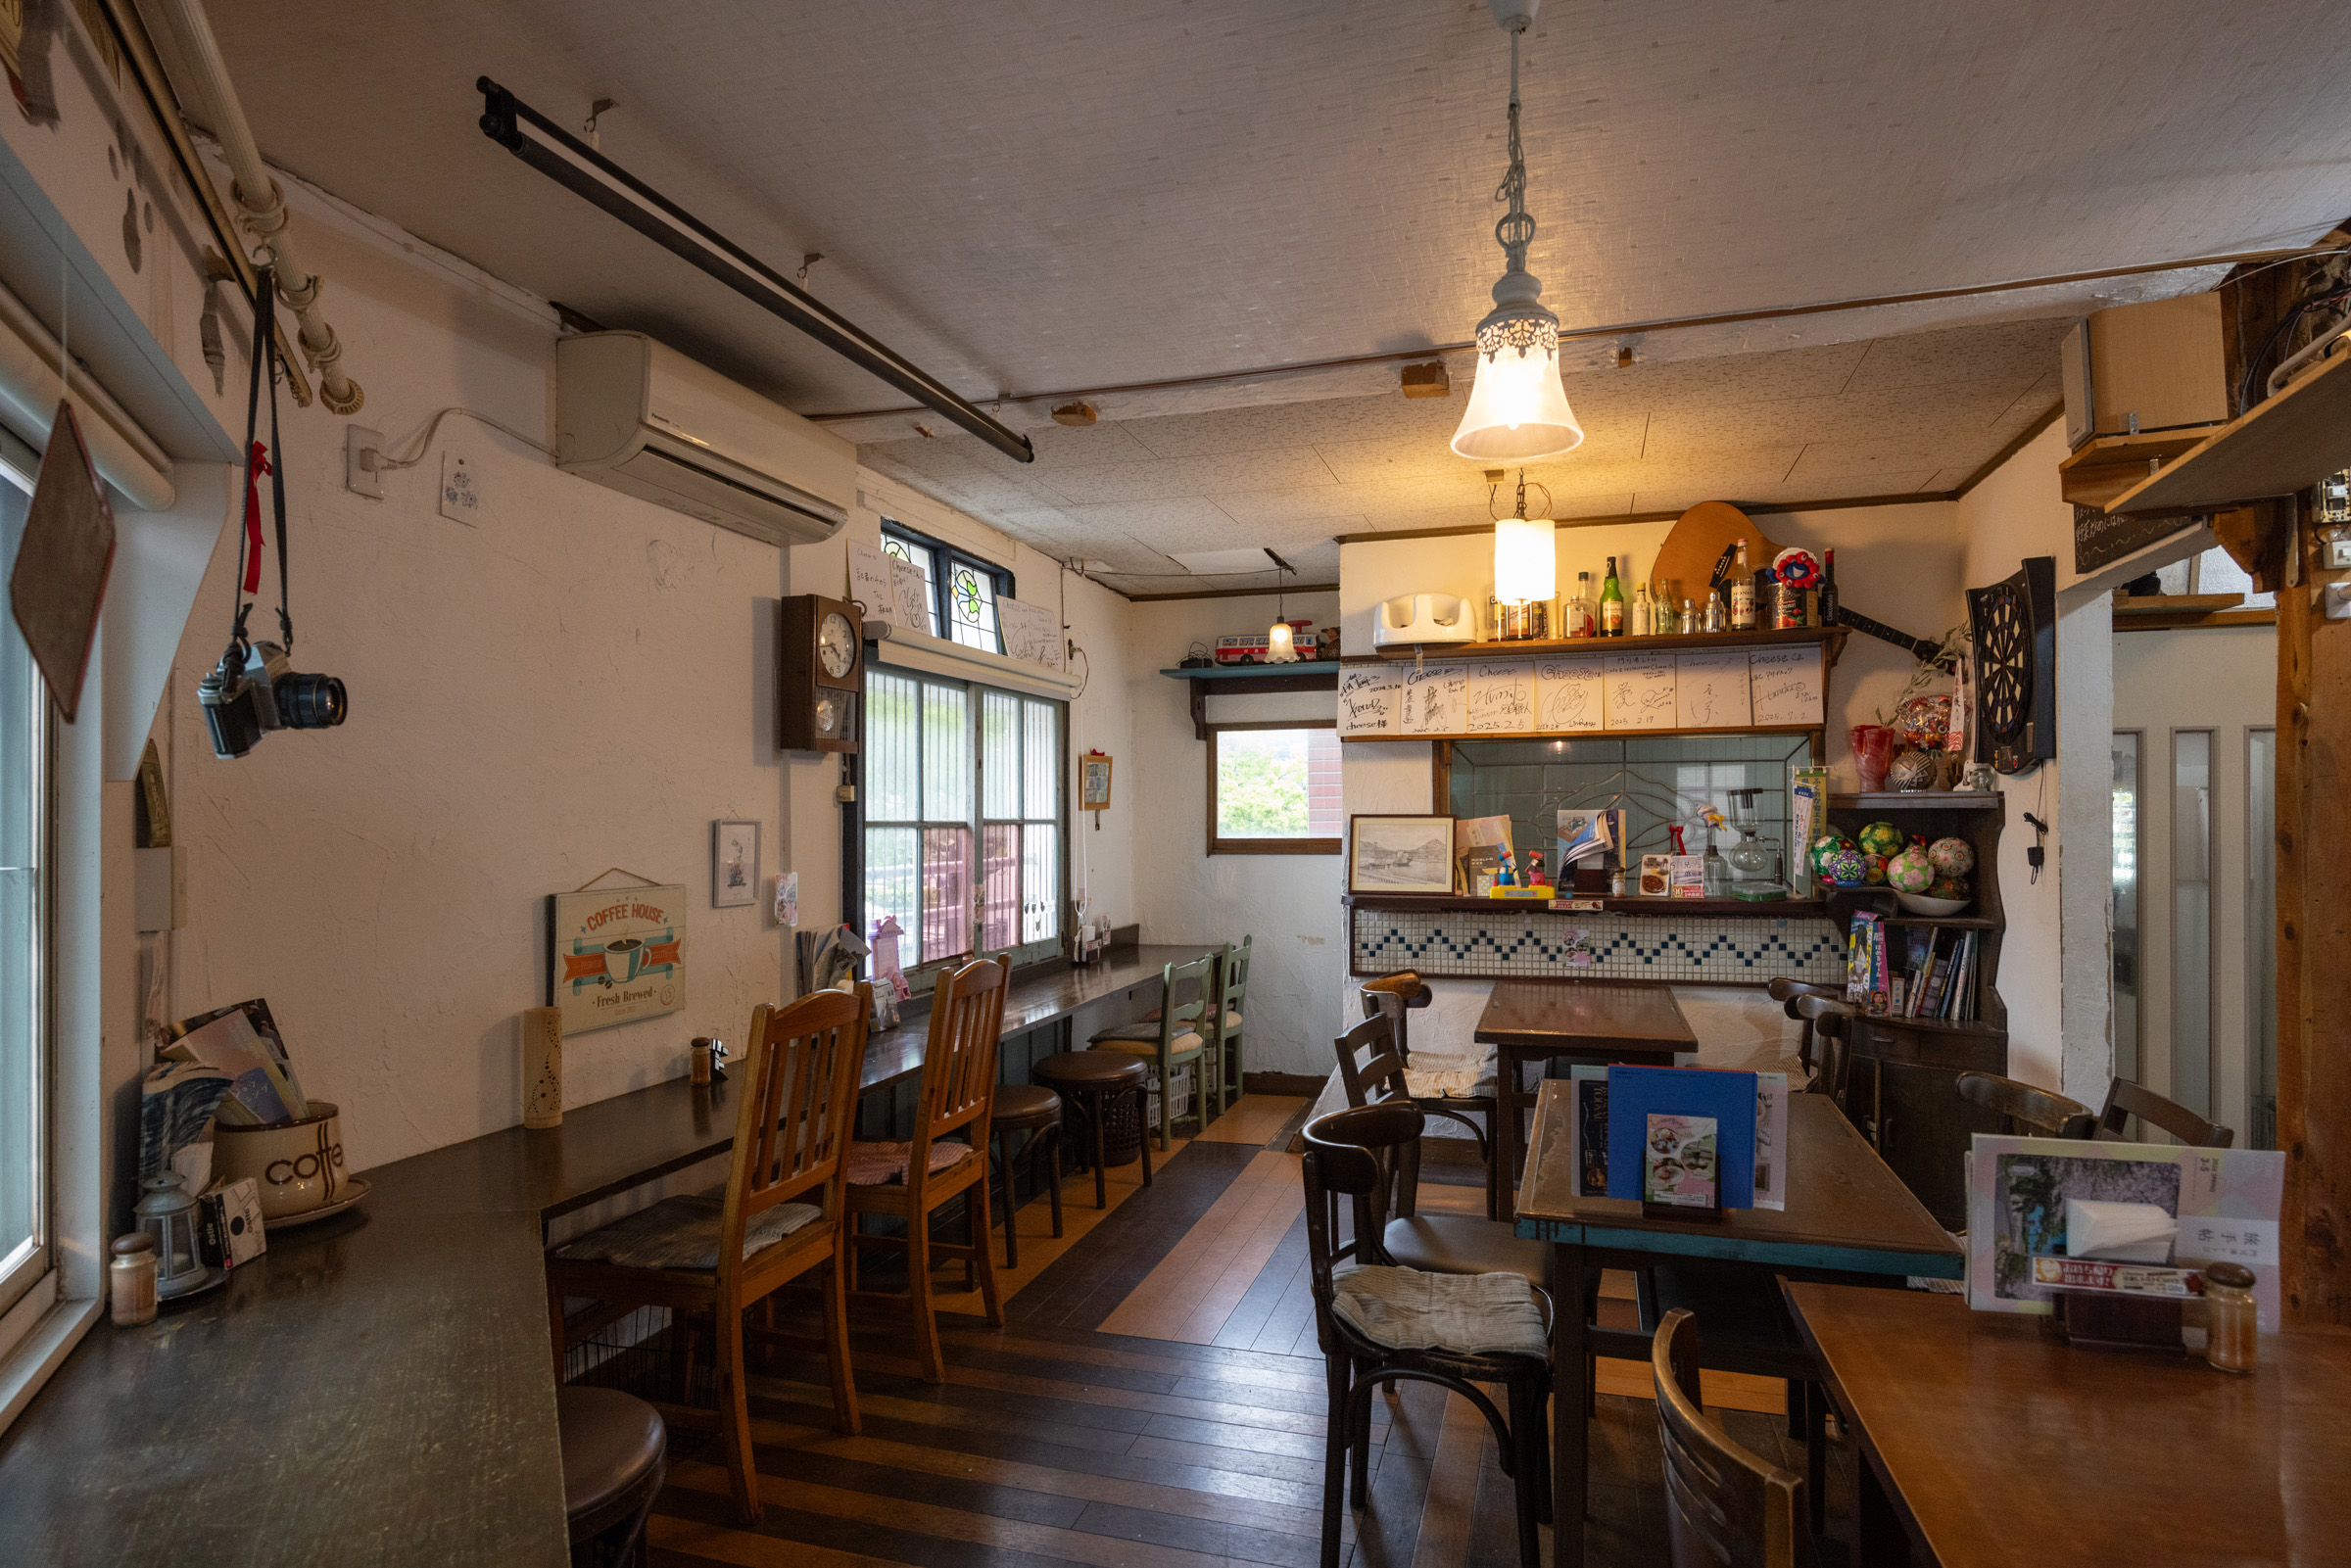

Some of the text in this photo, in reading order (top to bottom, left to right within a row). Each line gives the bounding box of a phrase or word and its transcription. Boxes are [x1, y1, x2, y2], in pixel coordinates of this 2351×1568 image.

[1750, 652, 1789, 665] Cheese
[587, 903, 665, 931] COFFEE HOUSE
[597, 986, 653, 1008] Fresh Brewed
[2062, 1263, 2114, 1276] お持ち帰り
